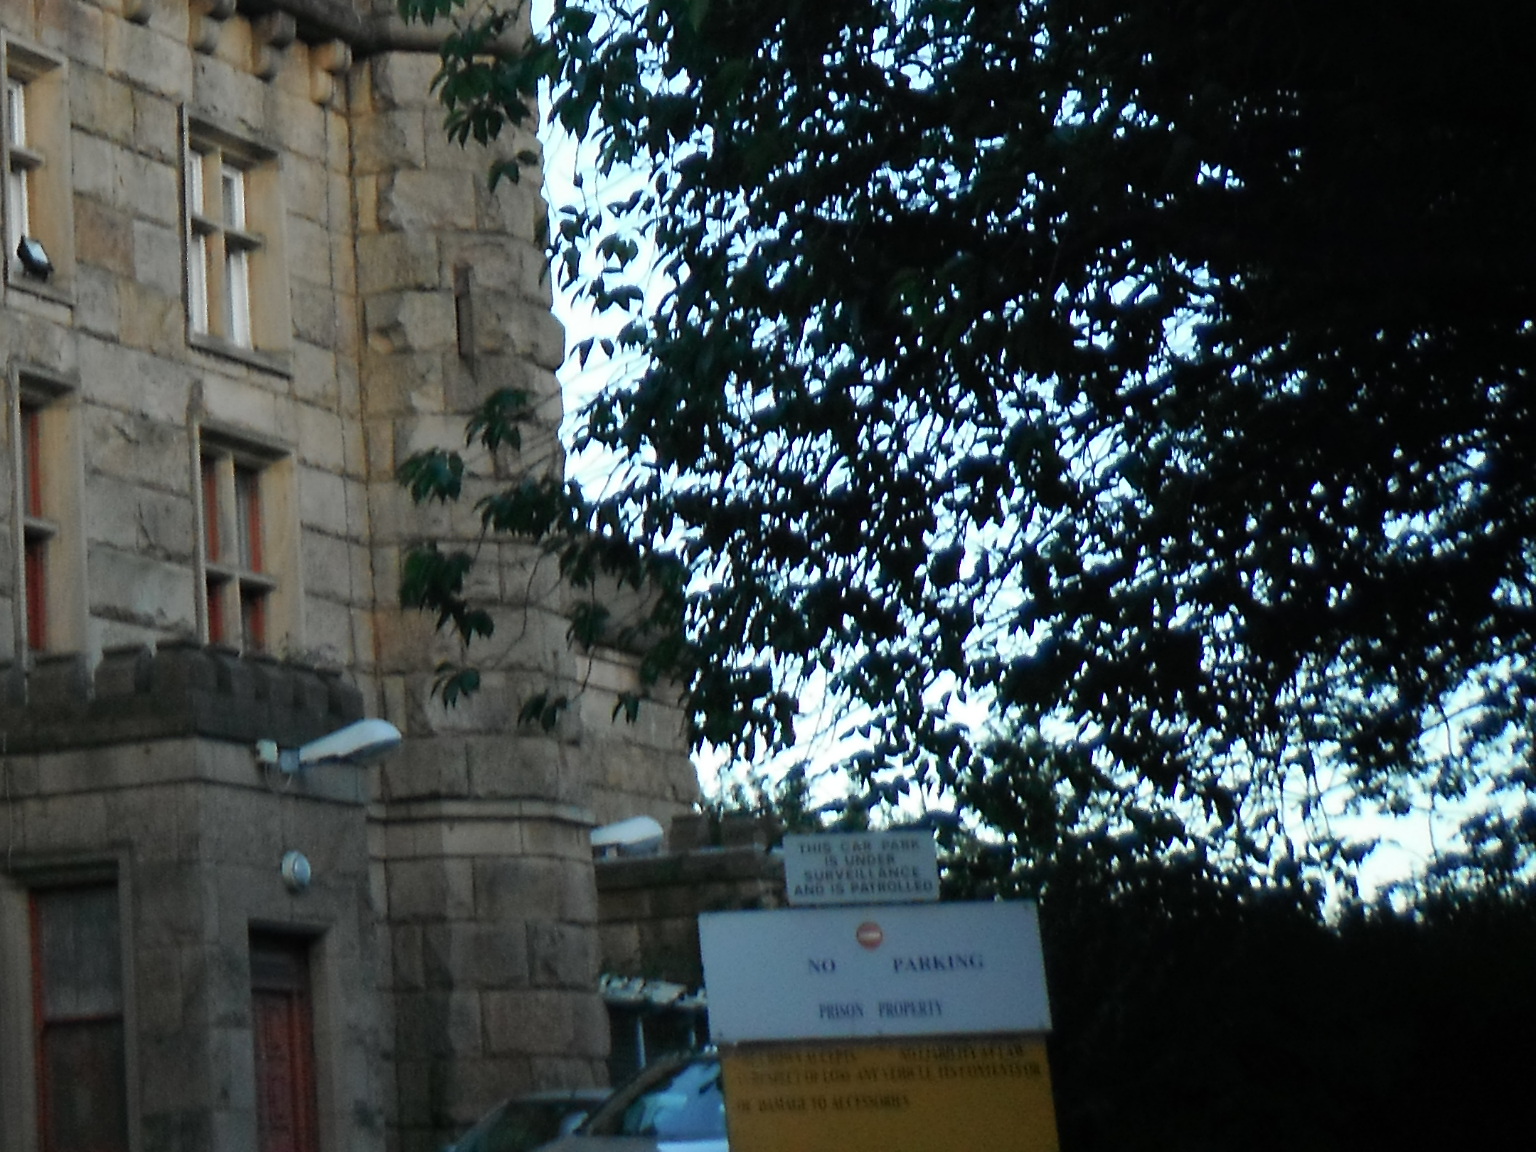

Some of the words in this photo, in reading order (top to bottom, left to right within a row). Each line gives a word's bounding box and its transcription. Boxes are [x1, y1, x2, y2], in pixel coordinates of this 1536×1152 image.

[799, 841, 831, 853] THIS
[840, 840, 871, 851] CAR
[881, 838, 919, 850] PARK
[824, 854, 837, 866] IS
[844, 853, 895, 865] UNDER
[804, 865, 919, 881] SURVEILLANCE
[794, 884, 824, 896] AND
[830, 883, 844, 895] IS
[850, 880, 933, 894] PATROLLED
[808, 957, 836, 973] NO
[892, 953, 984, 973] PARKING
[818, 1002, 864, 1019] PRISON
[877, 999, 943, 1018] PROPERTY
